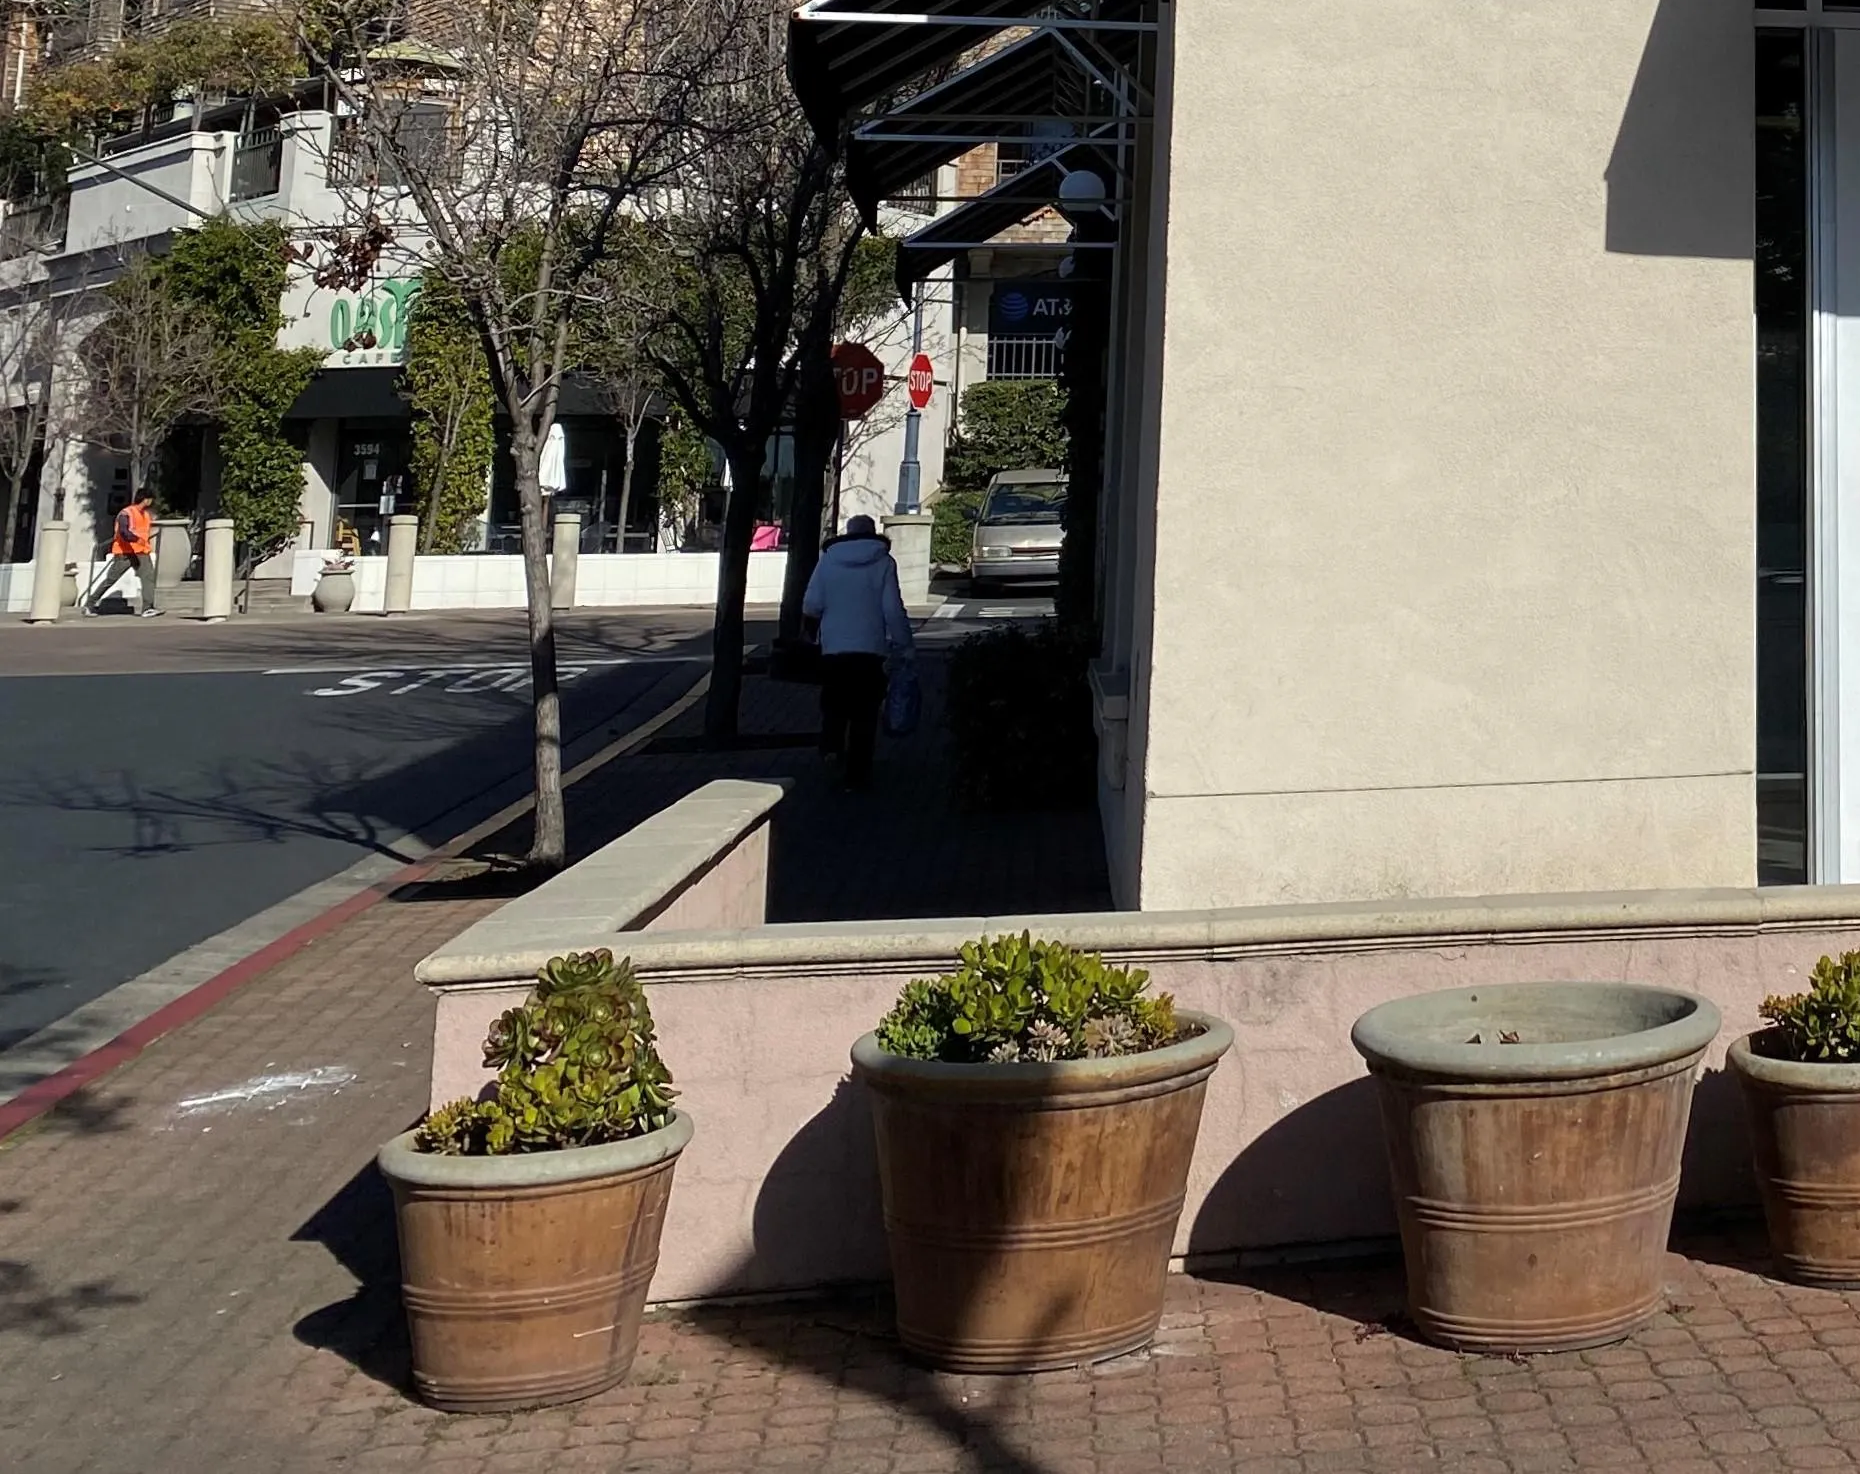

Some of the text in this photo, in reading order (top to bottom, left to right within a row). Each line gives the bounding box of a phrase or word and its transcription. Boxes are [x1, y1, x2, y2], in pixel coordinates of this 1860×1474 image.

[330, 280, 415, 350] OASI
[1032, 298, 1072, 316] AT&
[910, 370, 932, 392] STOP
[303, 667, 588, 696] STOP
